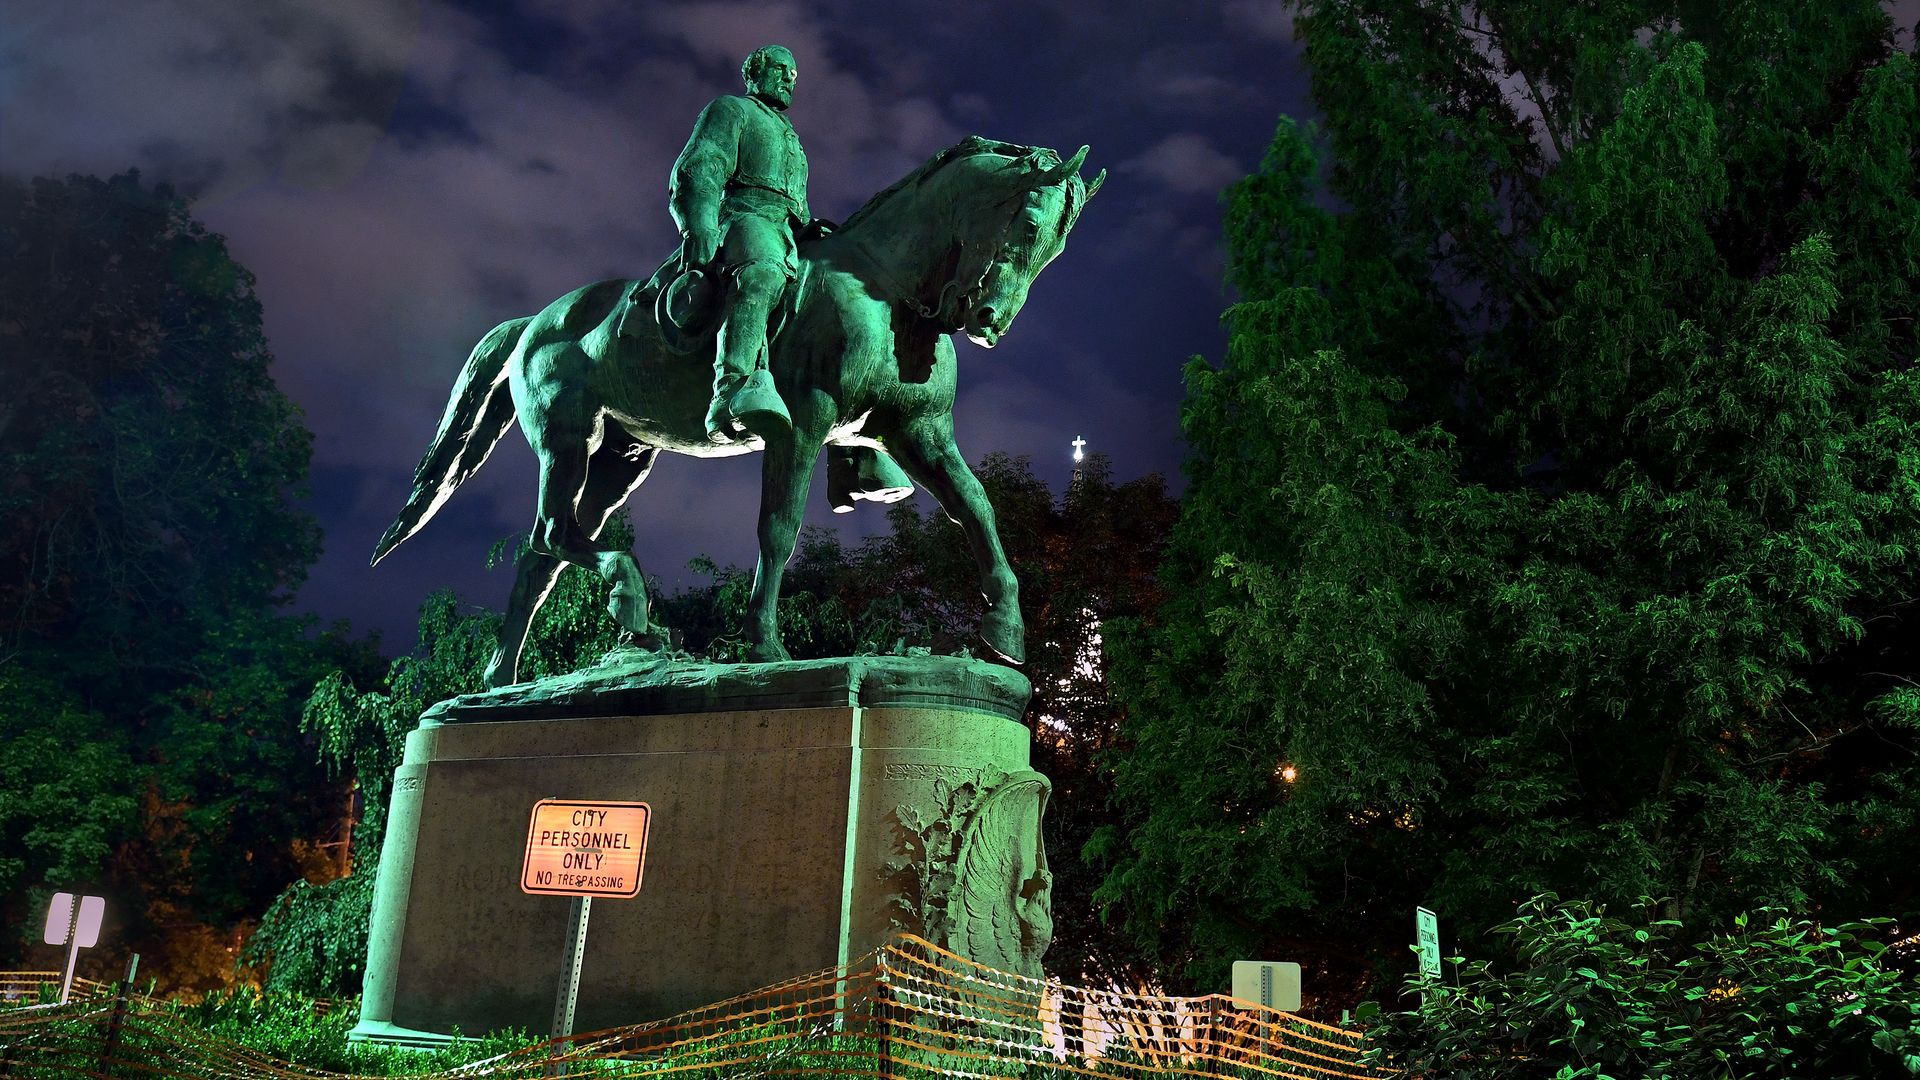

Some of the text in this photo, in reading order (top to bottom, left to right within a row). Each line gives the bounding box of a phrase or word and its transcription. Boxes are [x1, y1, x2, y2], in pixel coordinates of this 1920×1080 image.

[572, 809, 608, 827] CITY
[540, 831, 631, 849] PERSONNEL
[563, 853, 604, 870] ONLY
[535, 871, 624, 889] NO TRESPASSING
